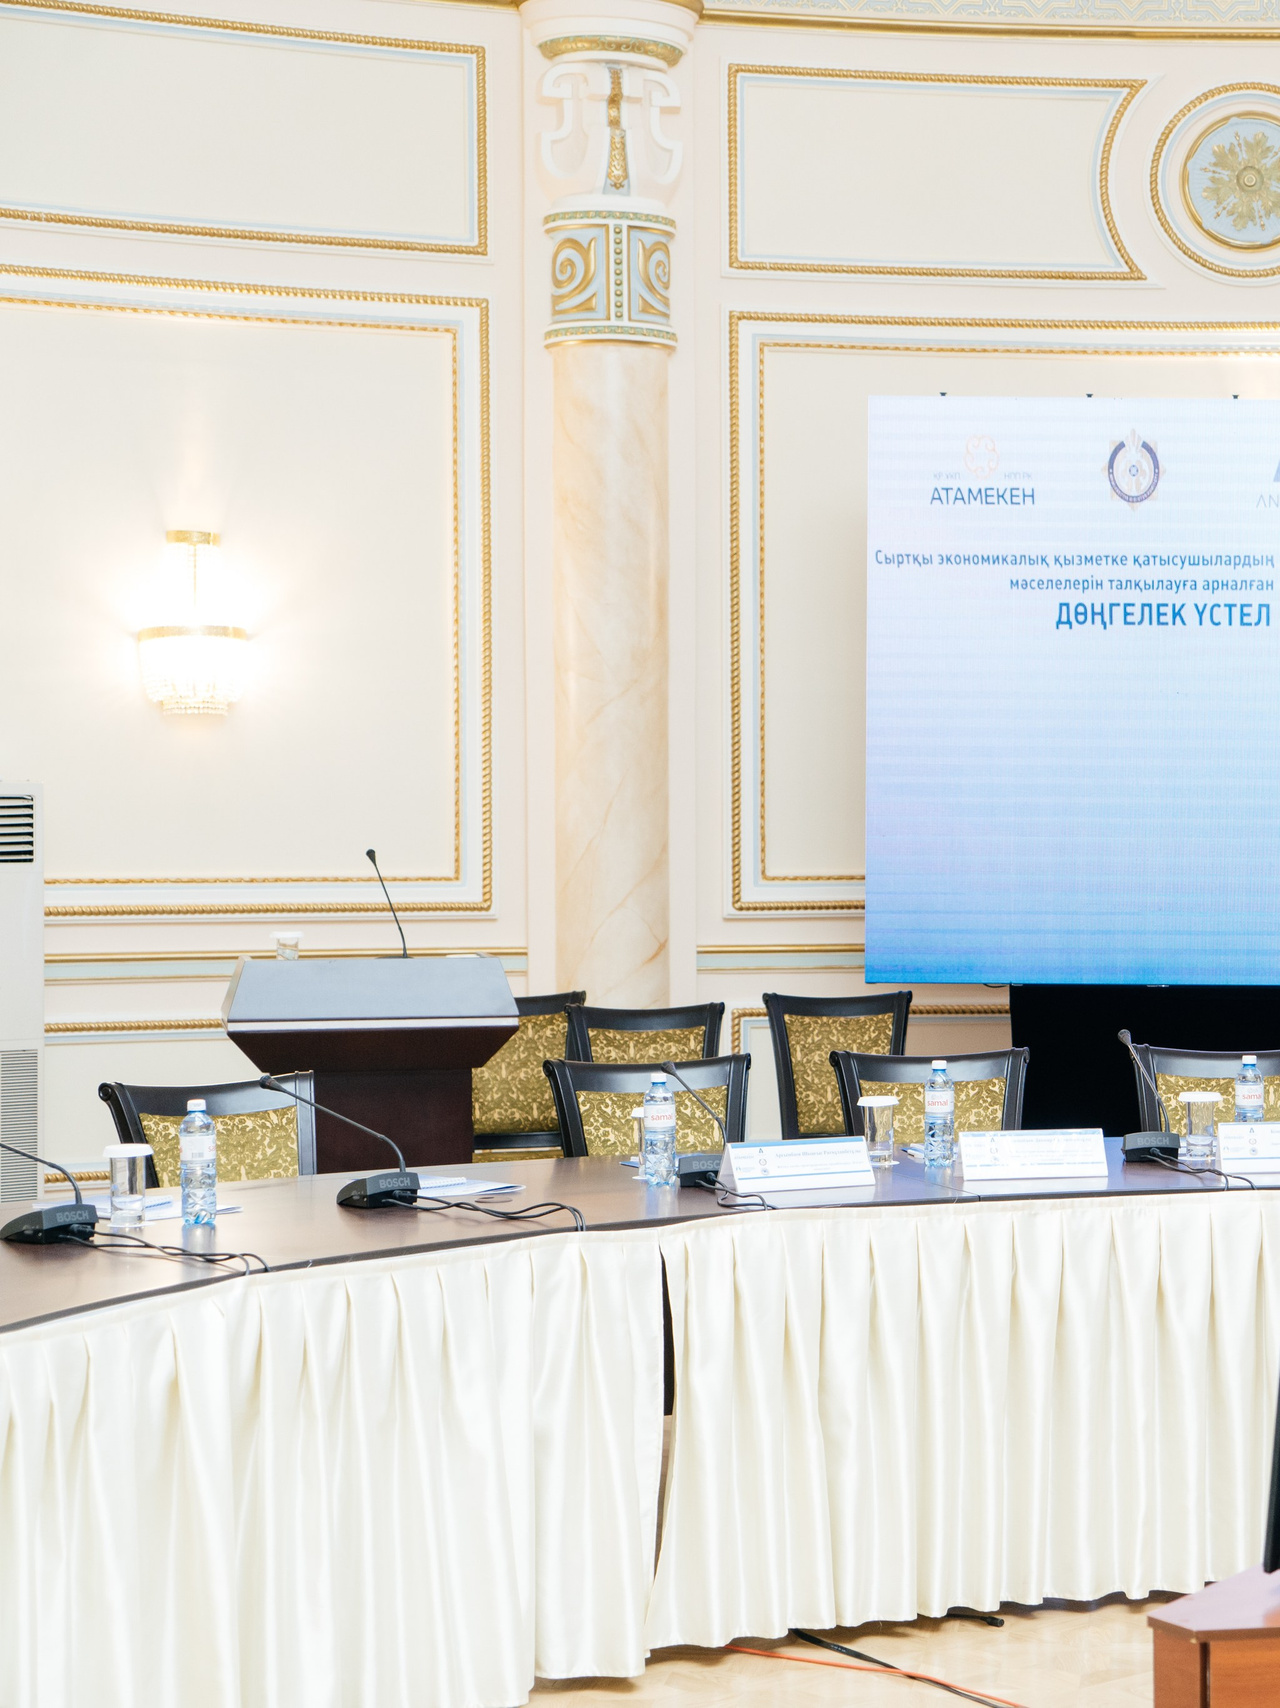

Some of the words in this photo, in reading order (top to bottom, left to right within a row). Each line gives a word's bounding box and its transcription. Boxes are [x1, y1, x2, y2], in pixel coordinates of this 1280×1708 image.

[930, 487, 1035, 505] АТАМЕКЕН
[875, 550, 933, 568] Сыртқы
[938, 554, 1049, 568] экономикалық
[1054, 554, 1127, 568] қызметке
[1133, 554, 1275, 570] қатысушылардың
[1010, 575, 1103, 593] мәселелерін
[1108, 580, 1197, 594] талқылауға
[1203, 580, 1274, 594] арналған
[1056, 602, 1187, 630] ДӨҢГЕЛЕК
[1194, 603, 1270, 626] ҮСТЕЛ
[1137, 1137, 1169, 1145] BOSCH
[692, 1161, 720, 1169] BOSC
[379, 1177, 410, 1188] BOSCH
[56, 1210, 89, 1222] BOSCH
